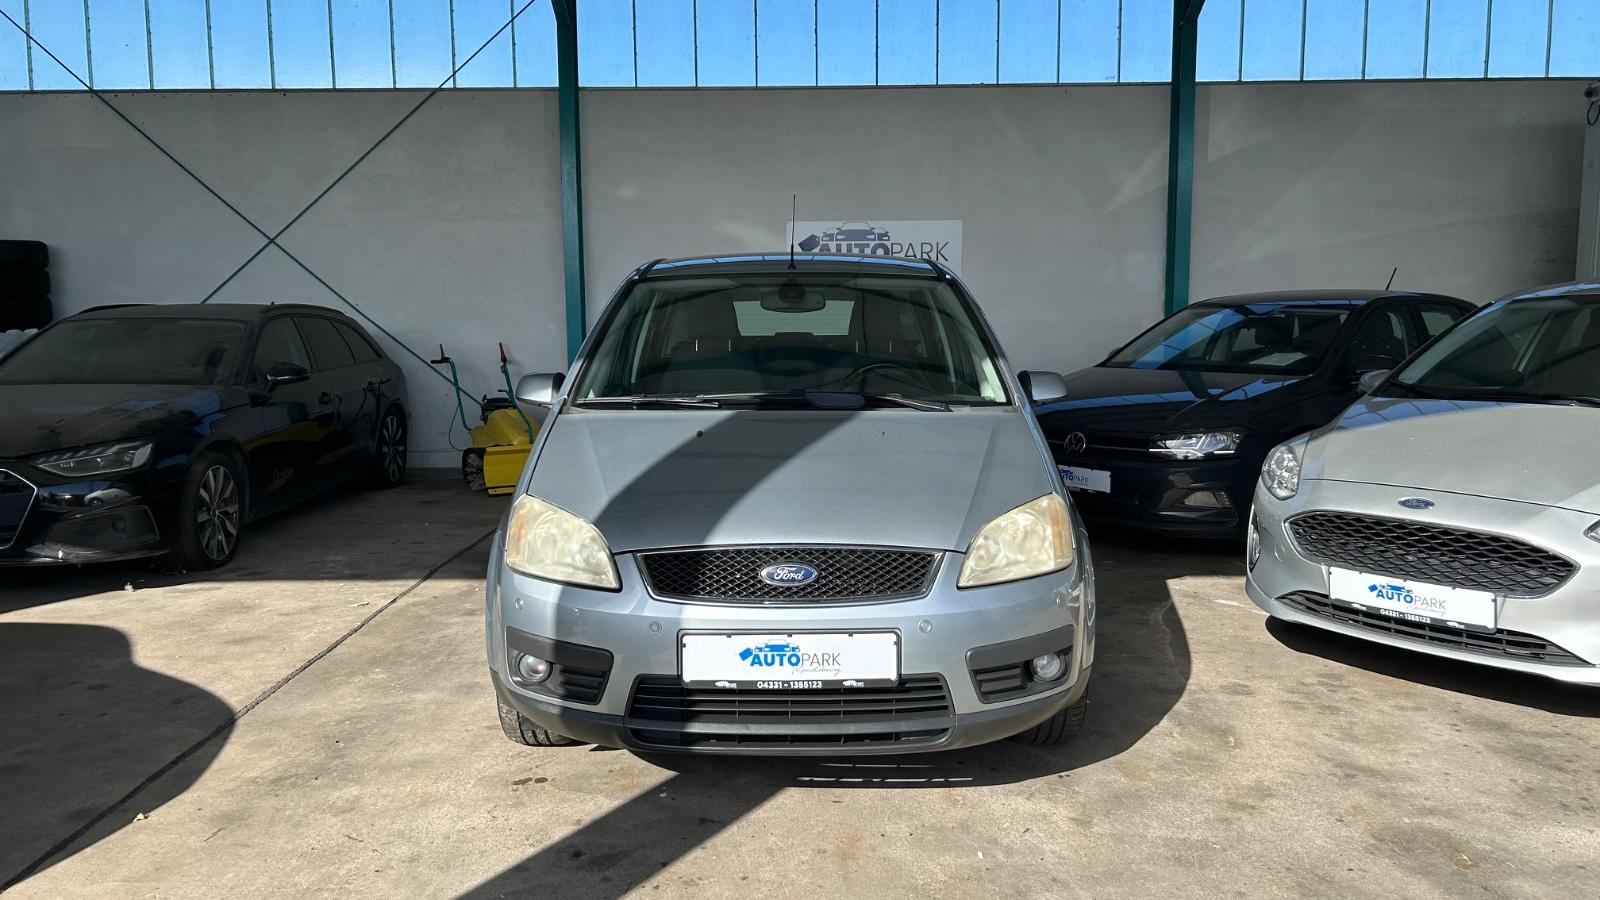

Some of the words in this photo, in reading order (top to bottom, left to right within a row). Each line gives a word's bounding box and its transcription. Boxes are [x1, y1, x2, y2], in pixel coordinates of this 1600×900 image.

[774, 567, 804, 580] Ford
[1376, 589, 1447, 610] AUTOPARK
[750, 652, 841, 667] AUTOPARK
[756, 680, 783, 689] 04331
[789, 680, 823, 689] 1355123
